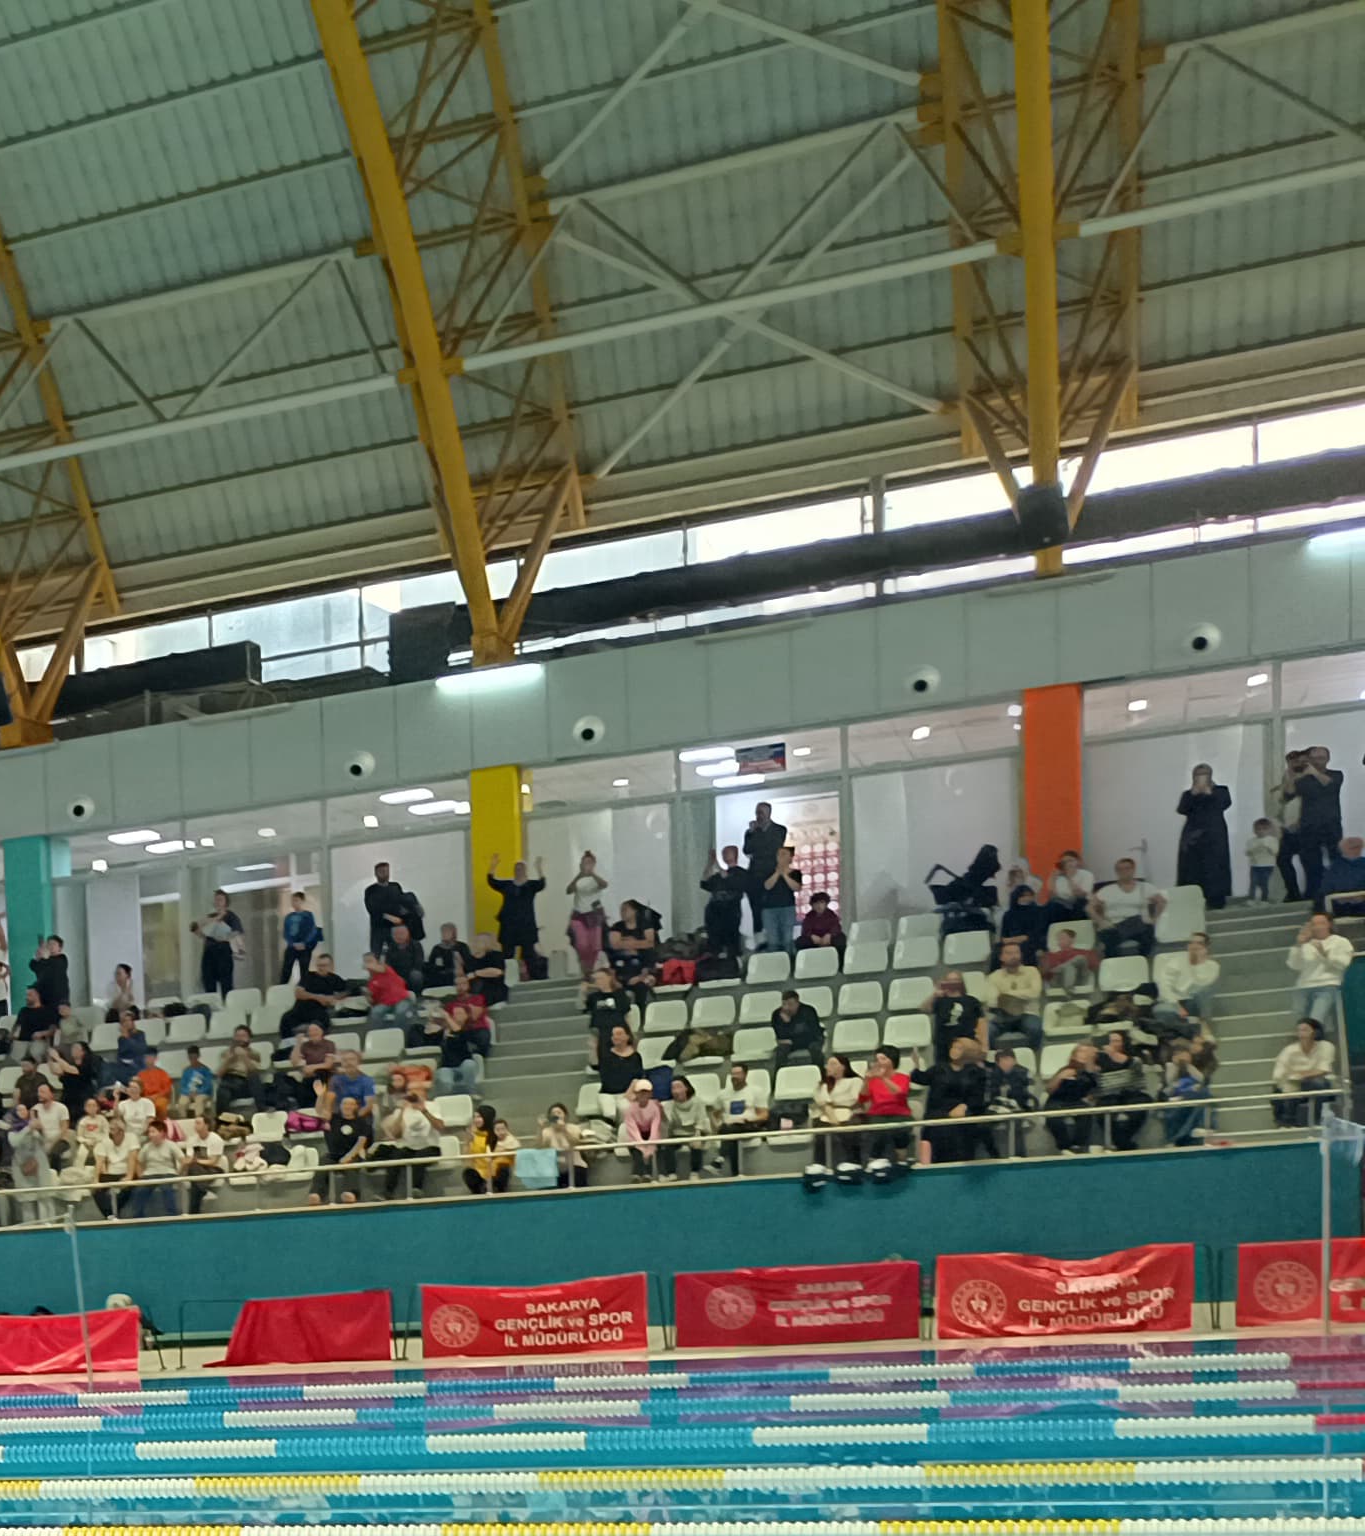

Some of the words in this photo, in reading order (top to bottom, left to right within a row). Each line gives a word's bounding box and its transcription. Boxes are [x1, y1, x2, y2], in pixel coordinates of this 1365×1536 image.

[525, 1297, 601, 1315] SAKARYA
[1018, 1296, 1096, 1314] GENÇLİK
[1101, 1295, 1122, 1308] ve
[1126, 1287, 1175, 1304] SPOR
[494, 1315, 563, 1332] GENÇLİK
[567, 1317, 585, 1327] ve
[588, 1311, 633, 1326] SPOR
[504, 1333, 518, 1347] İL
[521, 1328, 623, 1347] MÜDÜRLÜĞÜ
